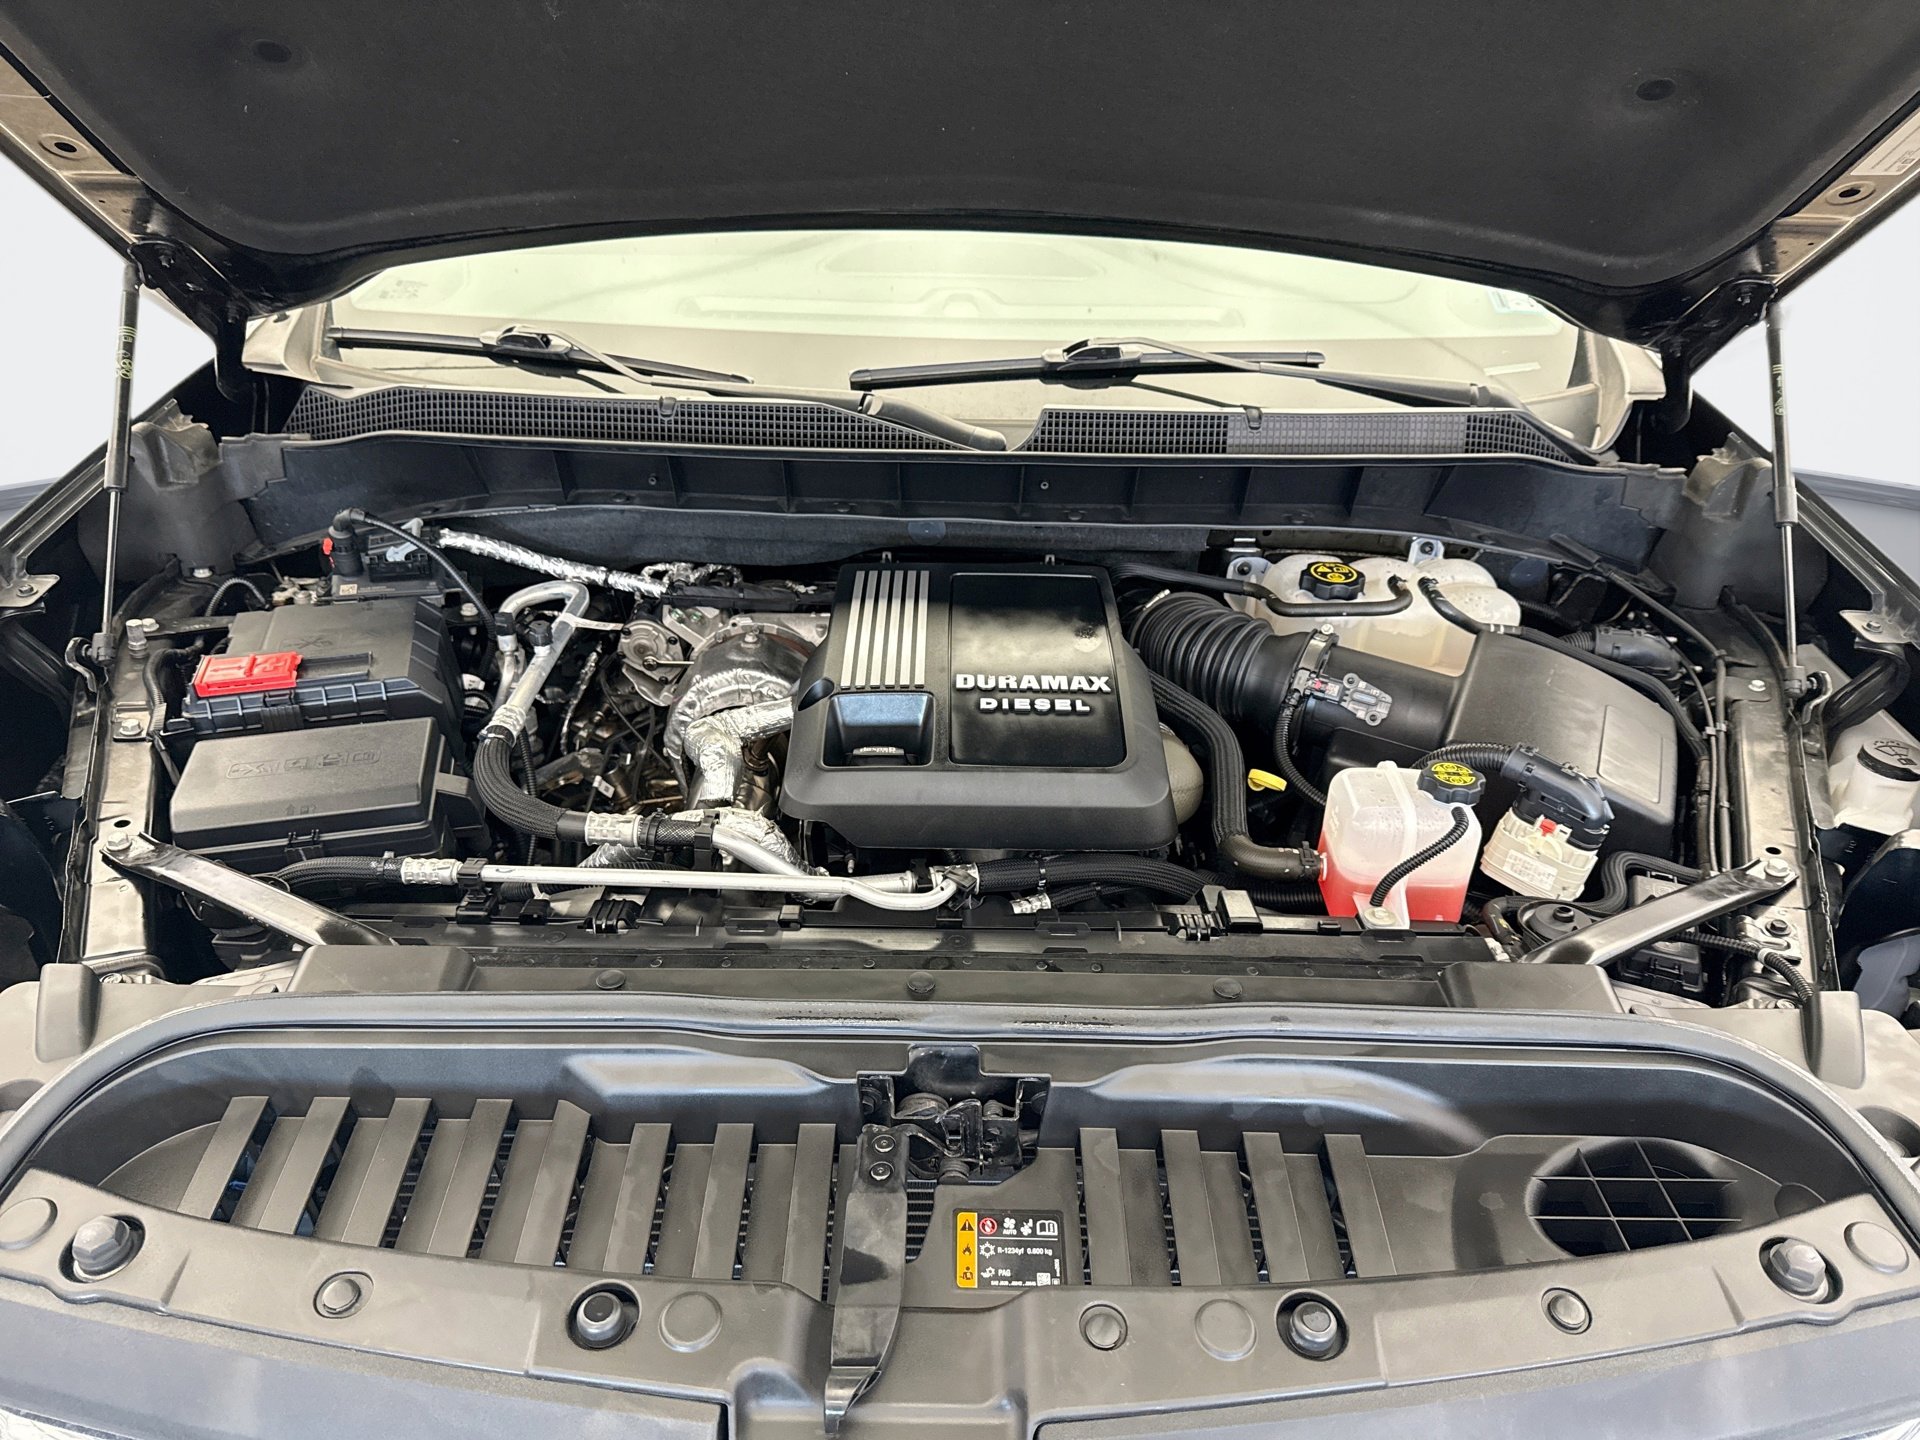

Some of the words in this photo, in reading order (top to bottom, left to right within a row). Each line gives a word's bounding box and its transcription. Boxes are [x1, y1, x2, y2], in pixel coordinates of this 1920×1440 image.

[955, 673, 1112, 692] DURAMAX
[979, 697, 1091, 712] DIESEL
[997, 1246, 1024, 1256] R-1234yf
[1044, 1247, 1053, 1256] kg
[998, 1268, 1011, 1277] PAG
